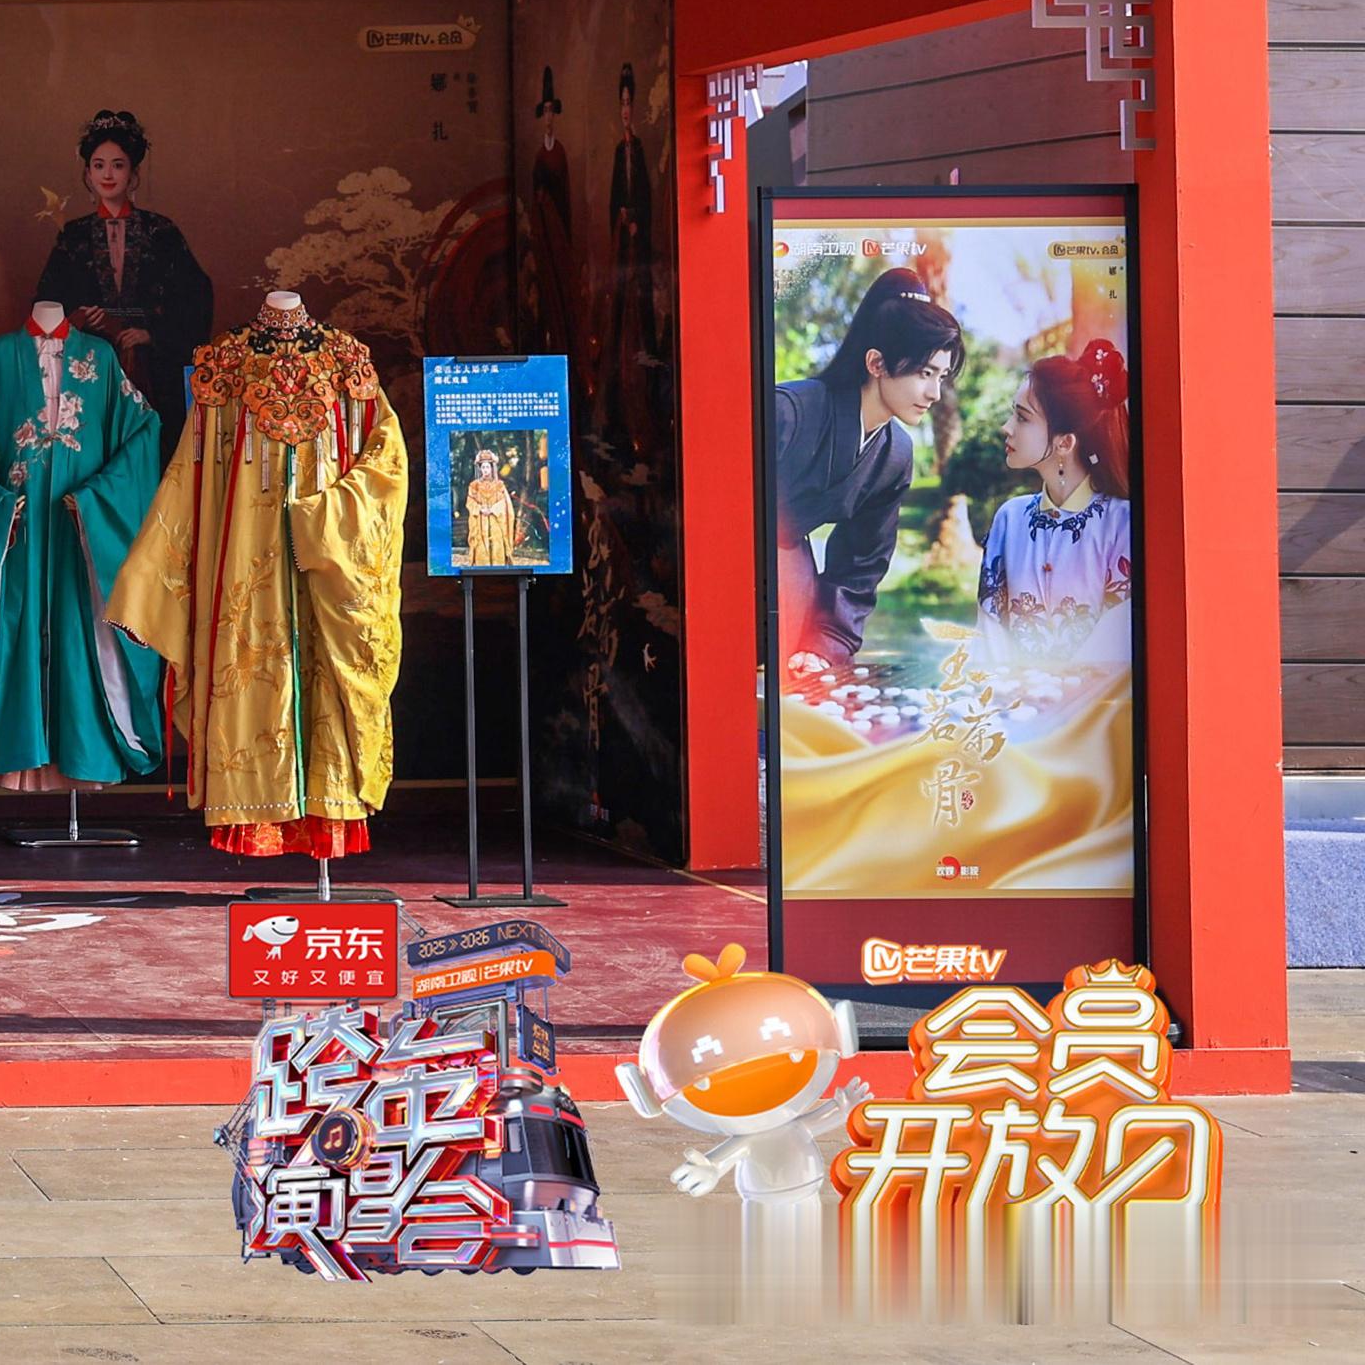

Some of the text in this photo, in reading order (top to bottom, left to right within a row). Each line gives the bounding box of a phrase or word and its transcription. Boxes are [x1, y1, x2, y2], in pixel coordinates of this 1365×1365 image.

[794, 242, 855, 255] 湖南卫视
[881, 242, 926, 255] 芒果tv
